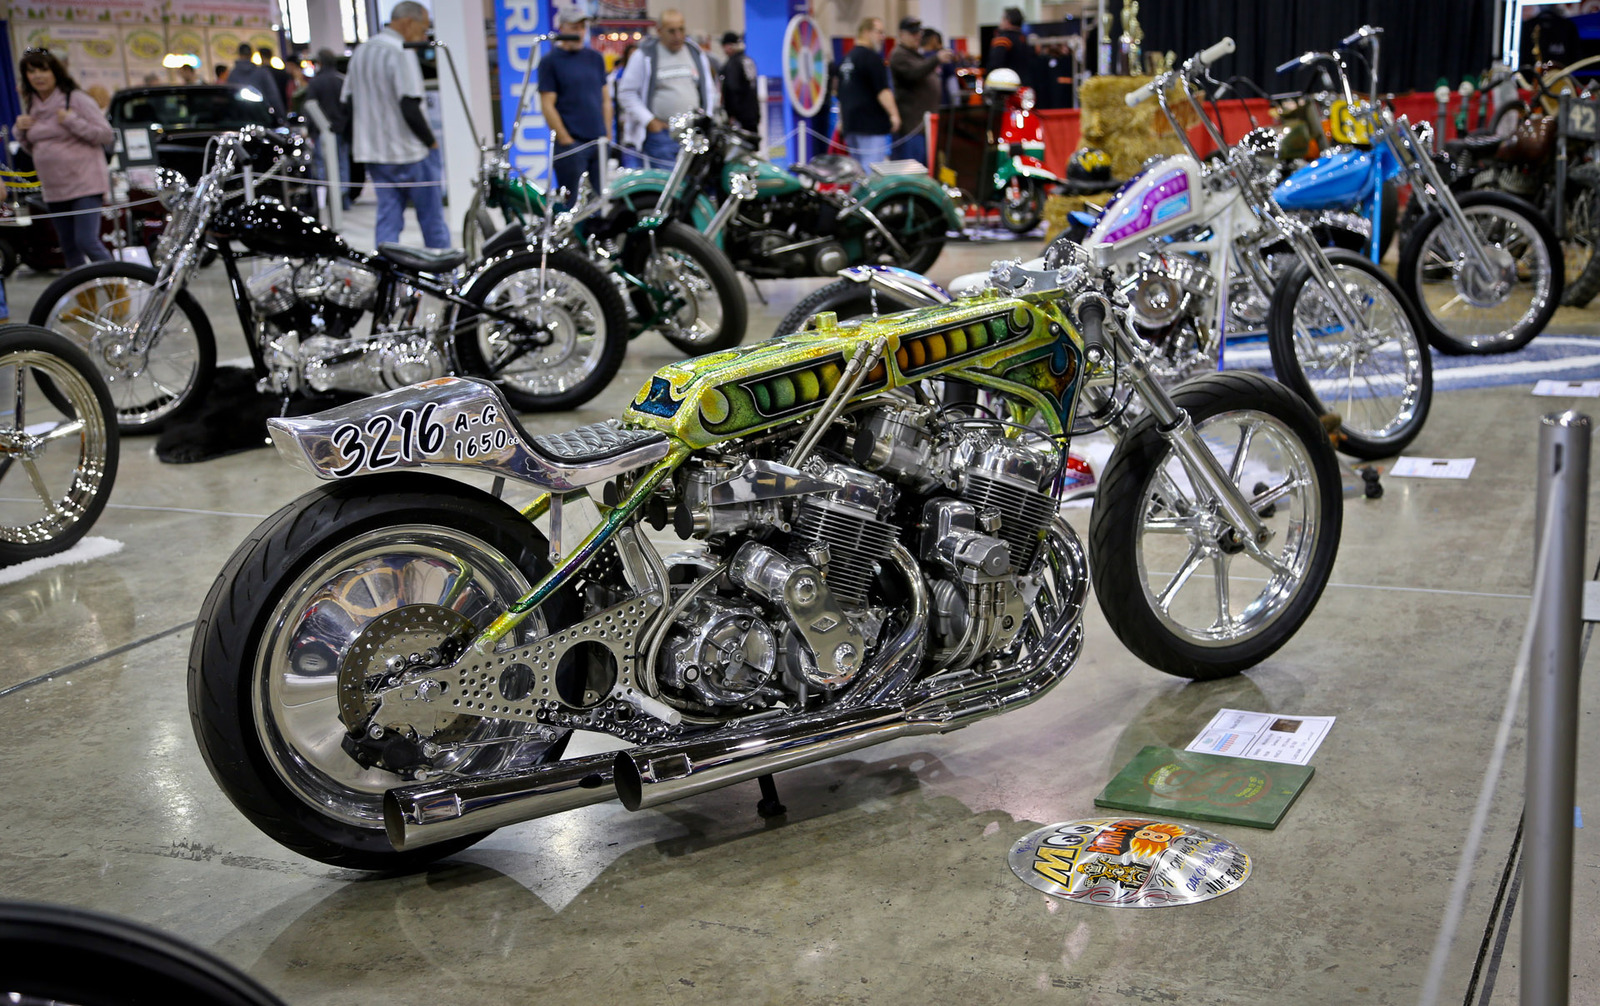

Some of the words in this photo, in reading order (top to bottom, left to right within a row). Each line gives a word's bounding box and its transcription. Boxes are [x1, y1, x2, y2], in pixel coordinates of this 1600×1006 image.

[453, 404, 499, 435] A-G
[330, 402, 446, 479] 3216
[1134, 829, 1172, 843] 8
